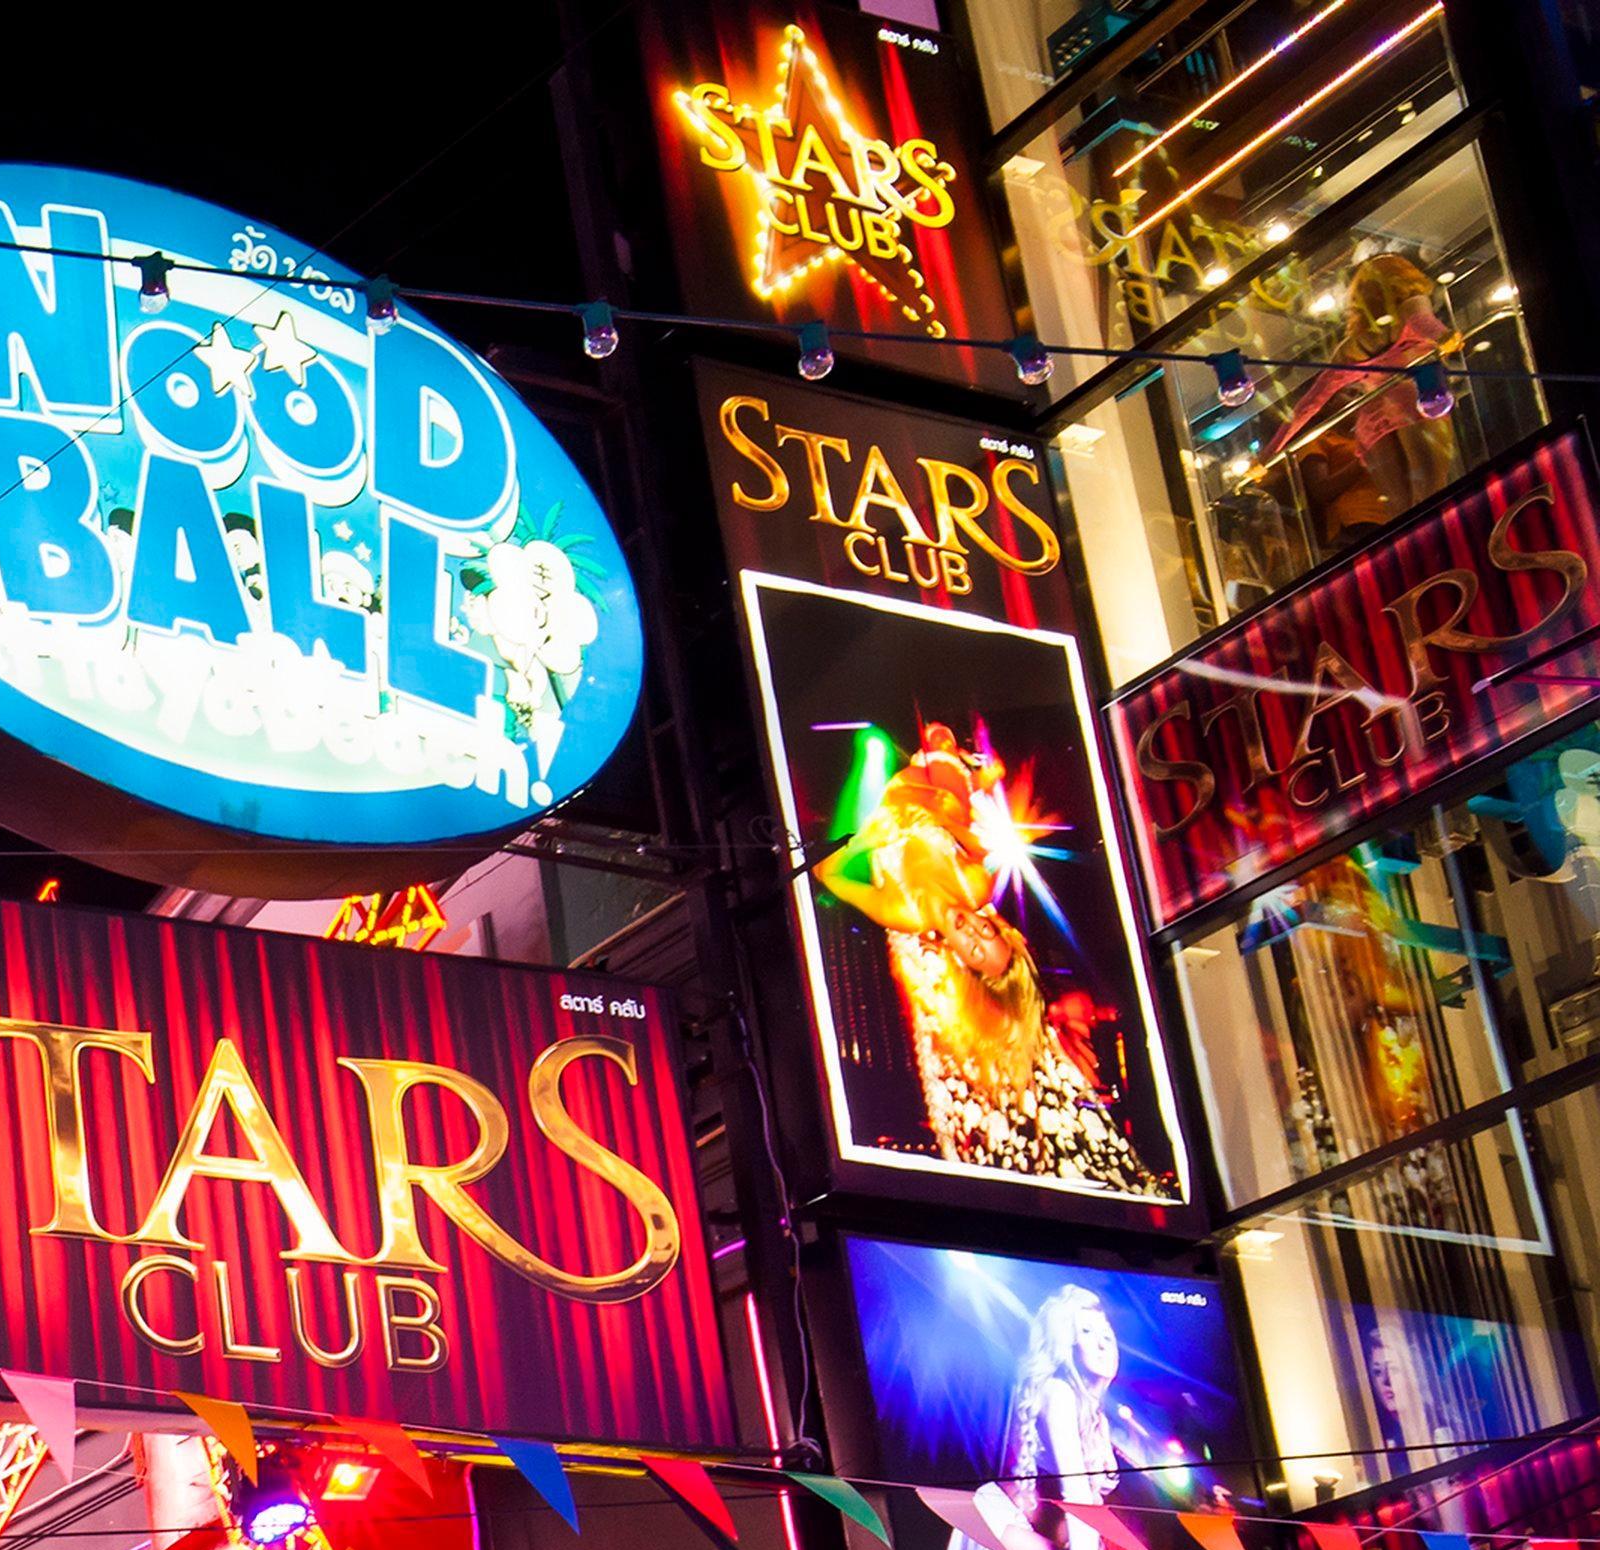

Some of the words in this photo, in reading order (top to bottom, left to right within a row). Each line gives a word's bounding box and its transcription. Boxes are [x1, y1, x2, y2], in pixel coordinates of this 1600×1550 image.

[690, 82, 956, 230] STARS
[760, 186, 903, 262] CLUB
[719, 396, 1061, 577] STARS
[844, 530, 975, 597] CLUB
[1137, 482, 1588, 840] STARS
[1288, 690, 1453, 806] CLUB
[608, 997, 646, 1021] คลับ
[120, 1250, 450, 1374] CLUB
